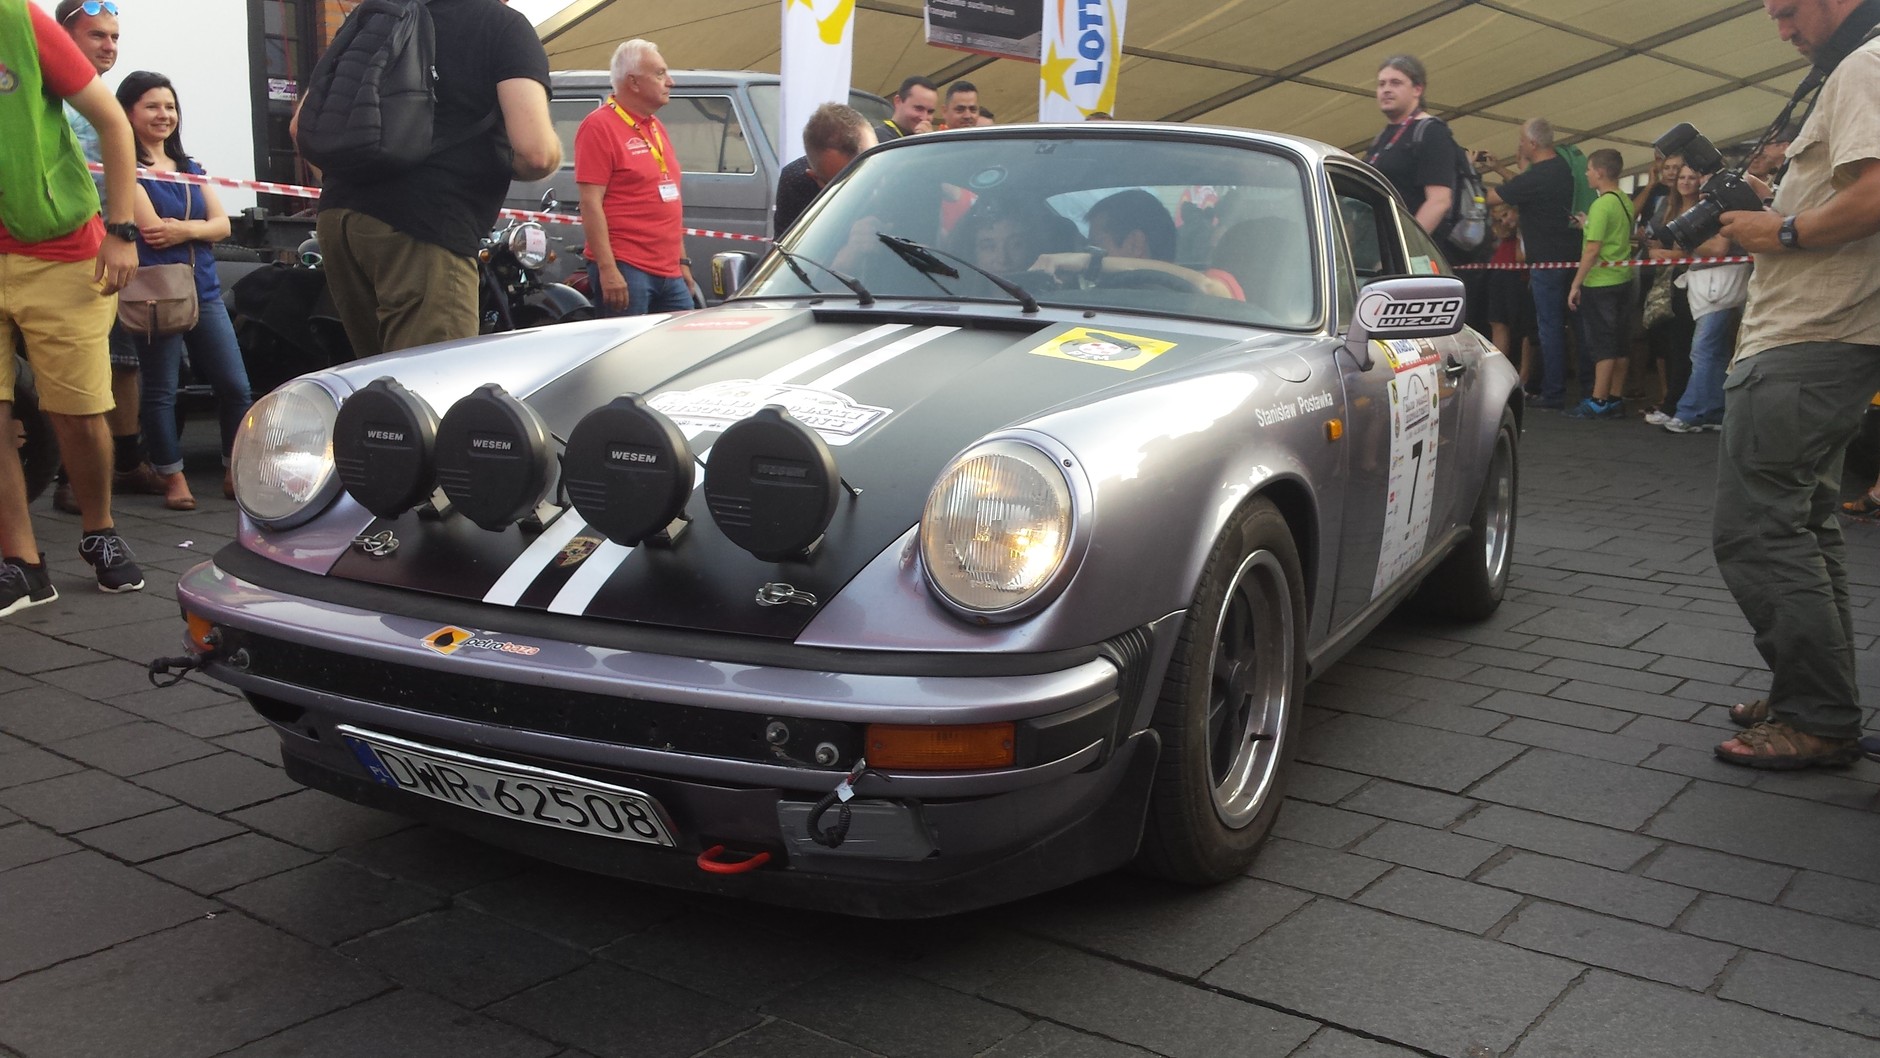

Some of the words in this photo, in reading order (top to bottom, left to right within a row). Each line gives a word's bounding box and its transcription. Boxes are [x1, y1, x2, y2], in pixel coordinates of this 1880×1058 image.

[1382, 300, 1460, 316] MOTO
[1378, 316, 1452, 327] WIZJA
[1254, 401, 1297, 427] Stanisław
[1297, 389, 1334, 415] Postawka
[367, 430, 404, 441] WESEM
[473, 439, 511, 450] WESEM
[611, 450, 657, 463] WESEM
[1407, 439, 1424, 525] 7
[369, 765, 391, 778] PL
[373, 749, 484, 808] DWR
[494, 778, 659, 839] 62508
